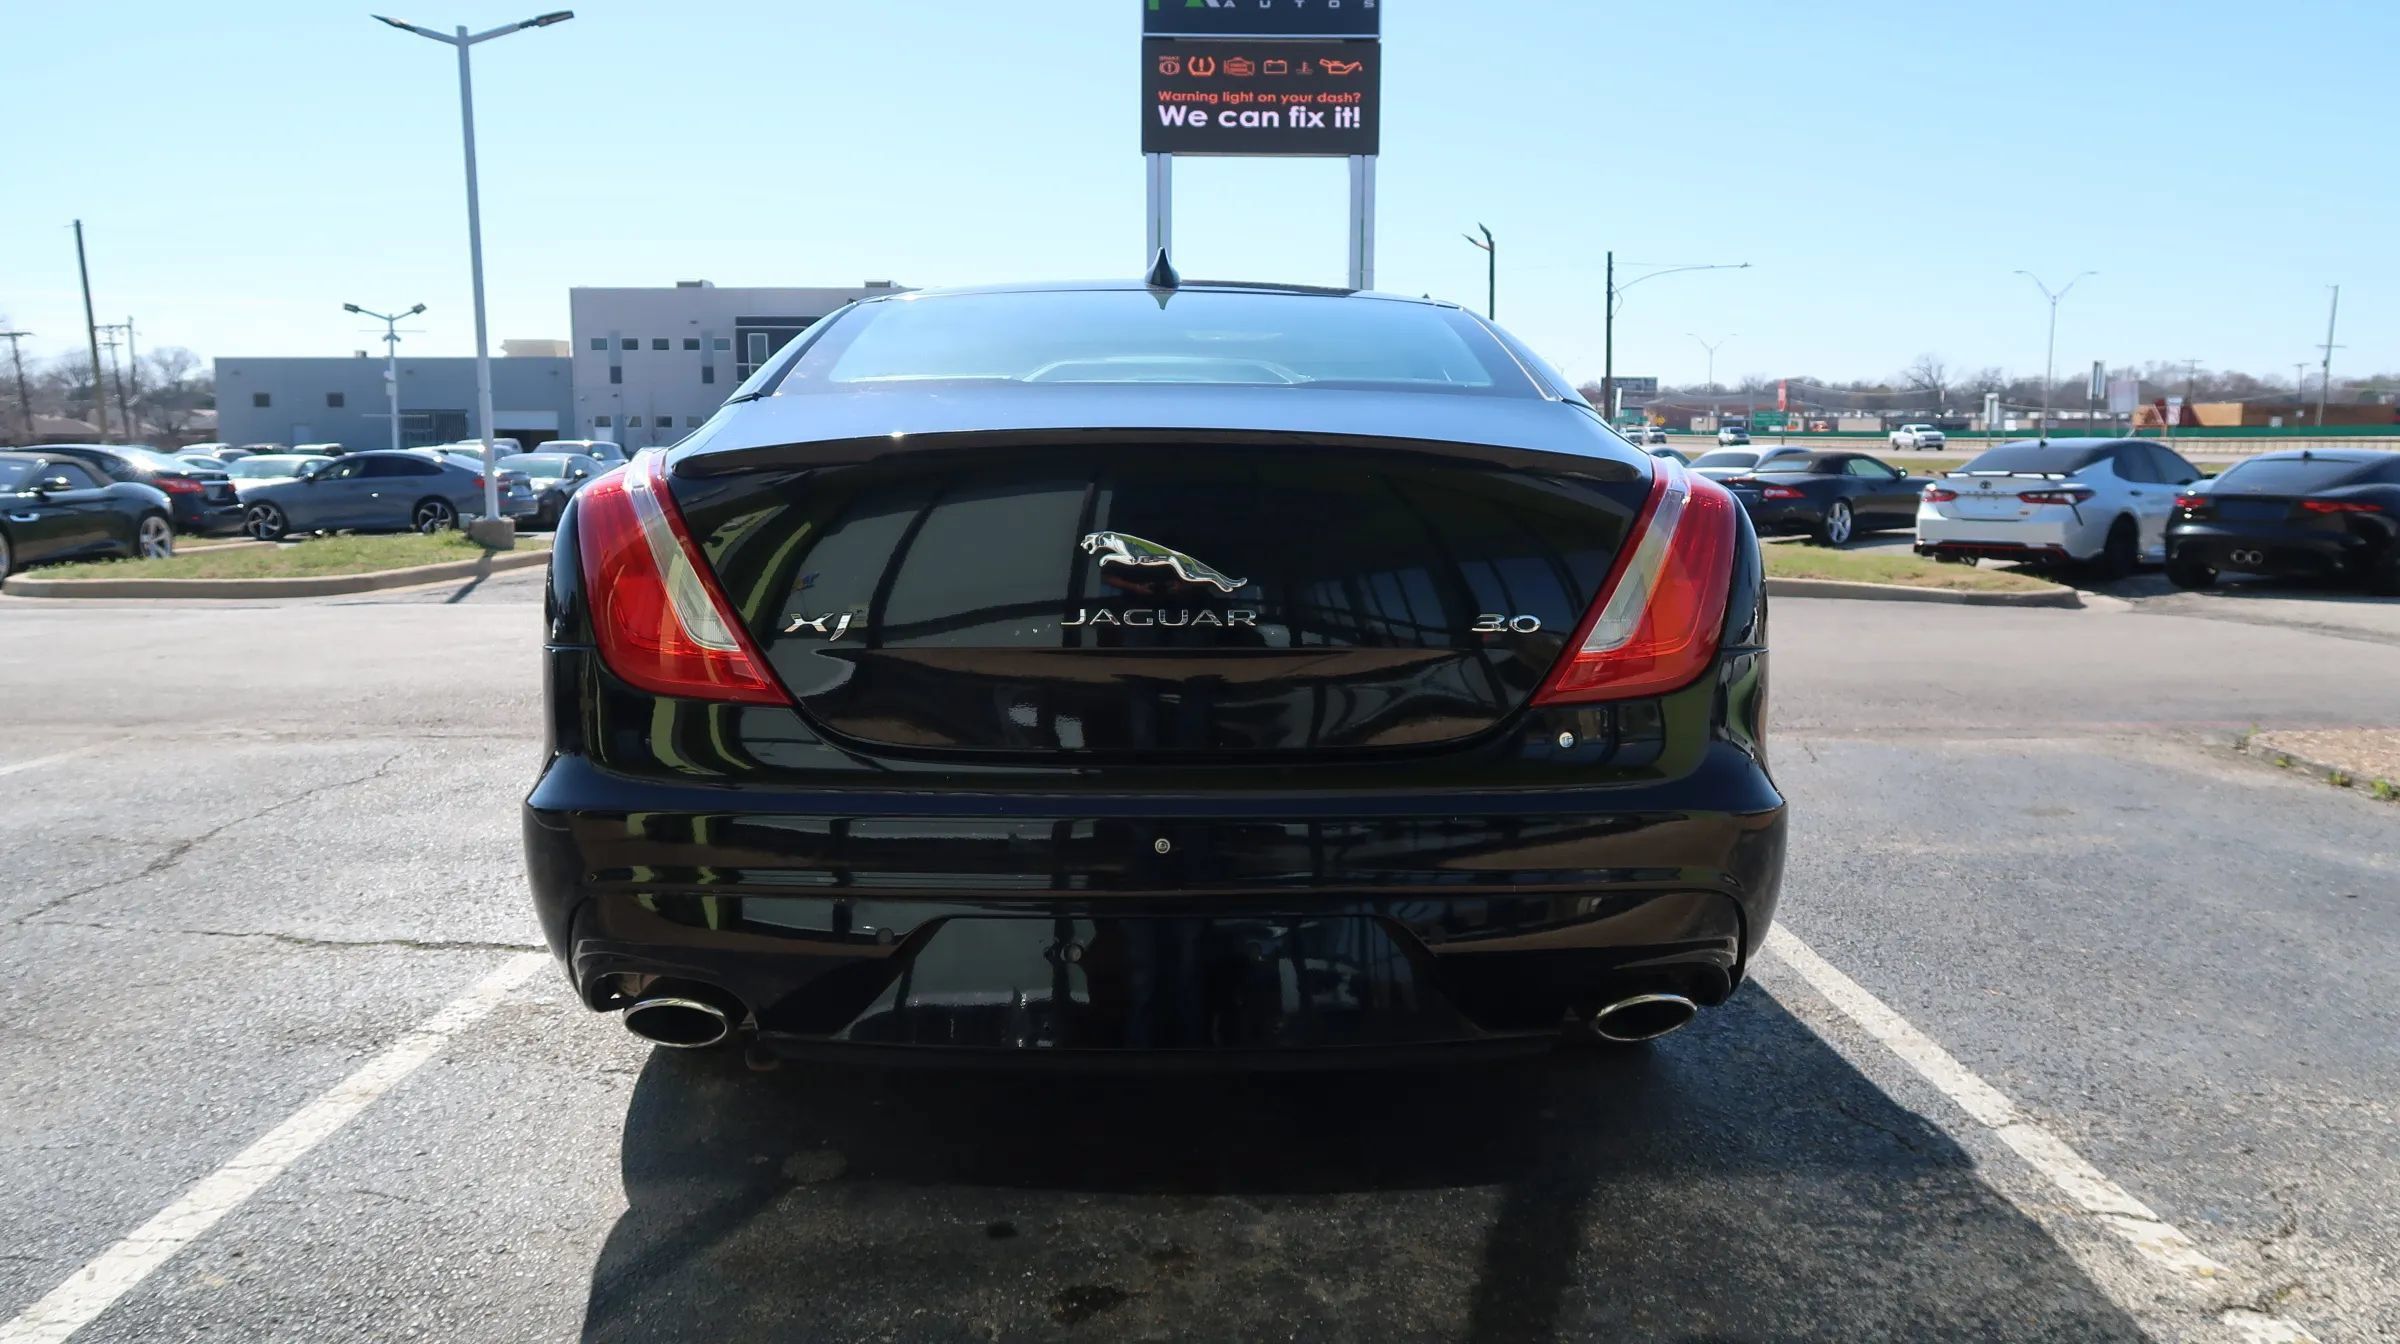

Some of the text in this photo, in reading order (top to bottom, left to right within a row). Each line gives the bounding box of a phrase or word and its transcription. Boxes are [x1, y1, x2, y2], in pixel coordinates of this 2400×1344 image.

[1223, 0, 1375, 8] AUTOS
[1158, 91, 1361, 105] Warning light on your dash?
[1158, 105, 1361, 128] We can fix it!
[783, 612, 853, 641] XJ
[1060, 608, 1257, 627] JAGUAR
